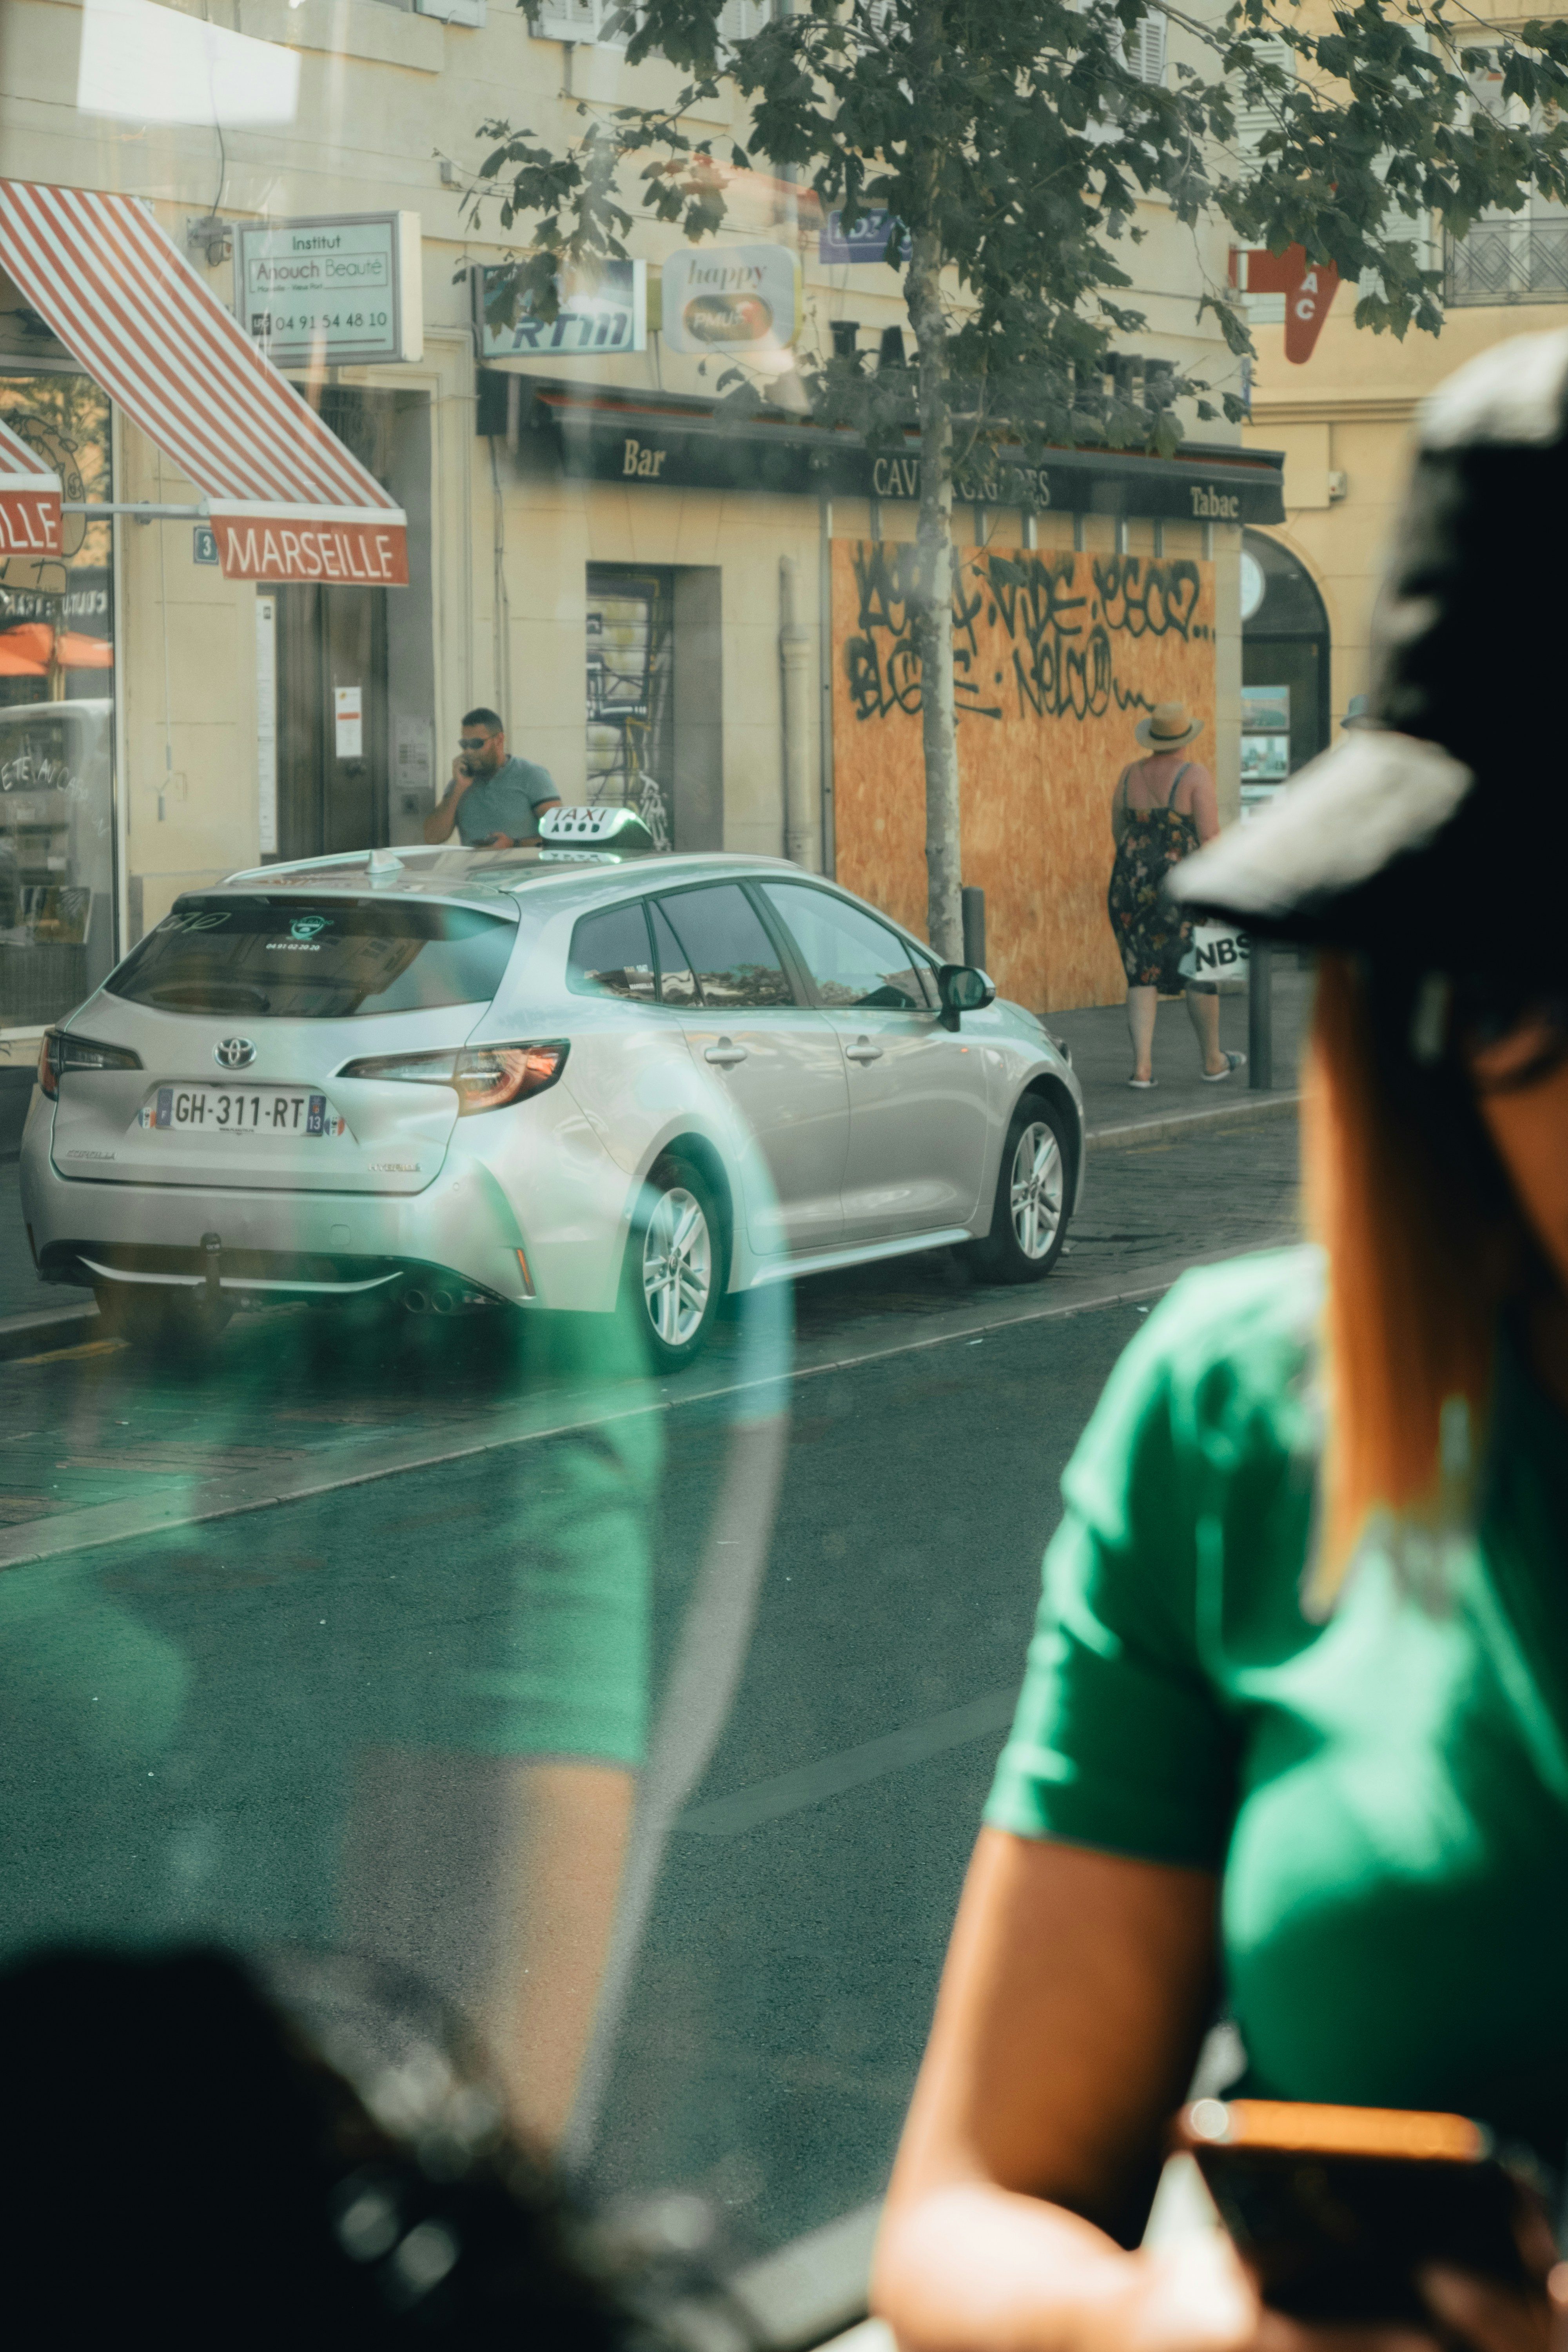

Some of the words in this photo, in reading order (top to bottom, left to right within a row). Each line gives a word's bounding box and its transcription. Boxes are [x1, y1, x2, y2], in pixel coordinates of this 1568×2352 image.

[292, 236, 341, 250] Institut
[257, 260, 320, 280] Anouch
[325, 259, 382, 277] Beauté
[688, 260, 767, 290] happy
[276, 316, 294, 330] 04
[299, 316, 316, 329] 91
[322, 315, 340, 328] 54
[347, 313, 363, 327] 48
[369, 312, 387, 325] 10
[623, 439, 666, 476] Bar
[1190, 485, 1239, 518] Tabac
[203, 535, 212, 556] 3
[226, 528, 392, 578] MARSEILLE
[555, 808, 607, 822] TAXI
[175, 1093, 305, 1128] GH-311-RT
[309, 1116, 321, 1129] 13
